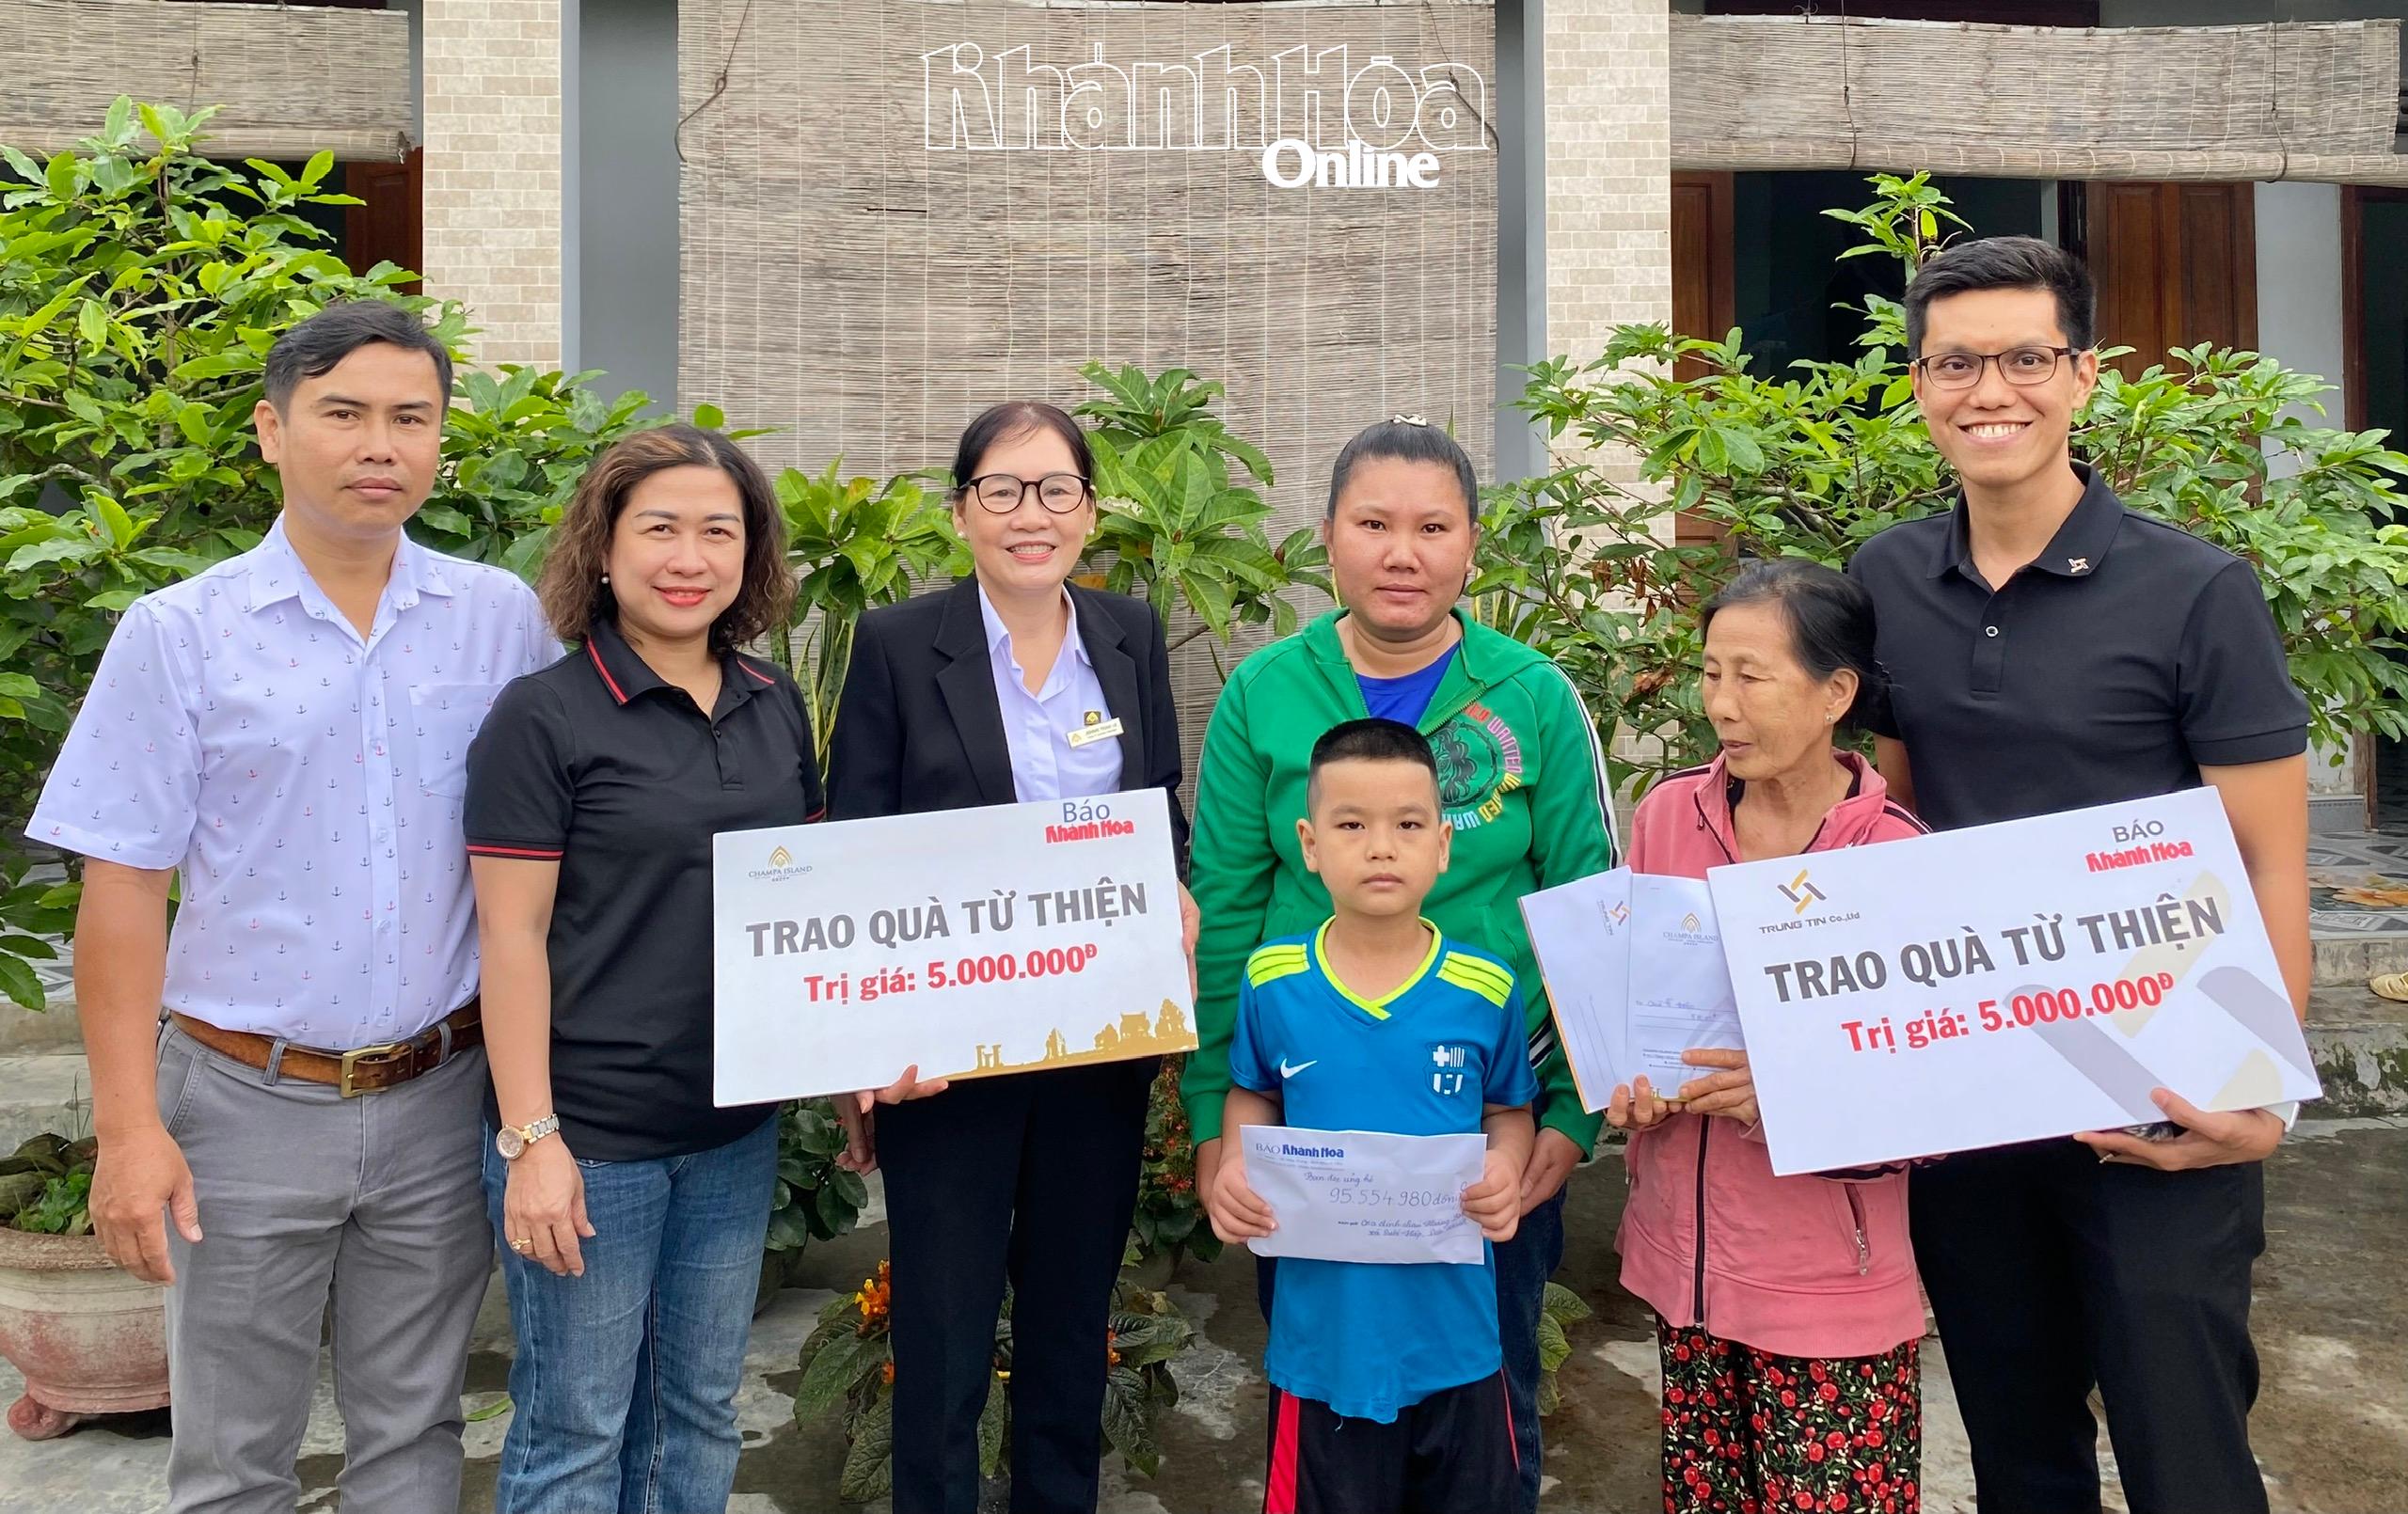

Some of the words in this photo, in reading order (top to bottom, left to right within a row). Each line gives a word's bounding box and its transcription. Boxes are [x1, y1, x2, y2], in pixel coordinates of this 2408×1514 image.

[1063, 798, 1110, 823] Báo
[2112, 818, 2164, 843] BÁO
[748, 868, 783, 878] CHAMPA
[784, 865, 813, 875] ISLAND
[745, 913, 856, 957] TRAO
[868, 895, 951, 949] QUÀ
[961, 889, 1017, 935] TỪ
[1027, 876, 1149, 929] THIỆN
[1758, 920, 1803, 934] TRUNG
[1805, 916, 1827, 927] TIN
[1765, 950, 1887, 1002] TRAO
[1900, 925, 1995, 986] QUÀ
[2002, 911, 2067, 966] TỪ
[2077, 892, 2225, 955] THIỆN
[803, 971, 848, 1005] Trị
[859, 966, 916, 1002] giá:
[1841, 1017, 1896, 1055] Trị
[1906, 1006, 1970, 1049] giá:
